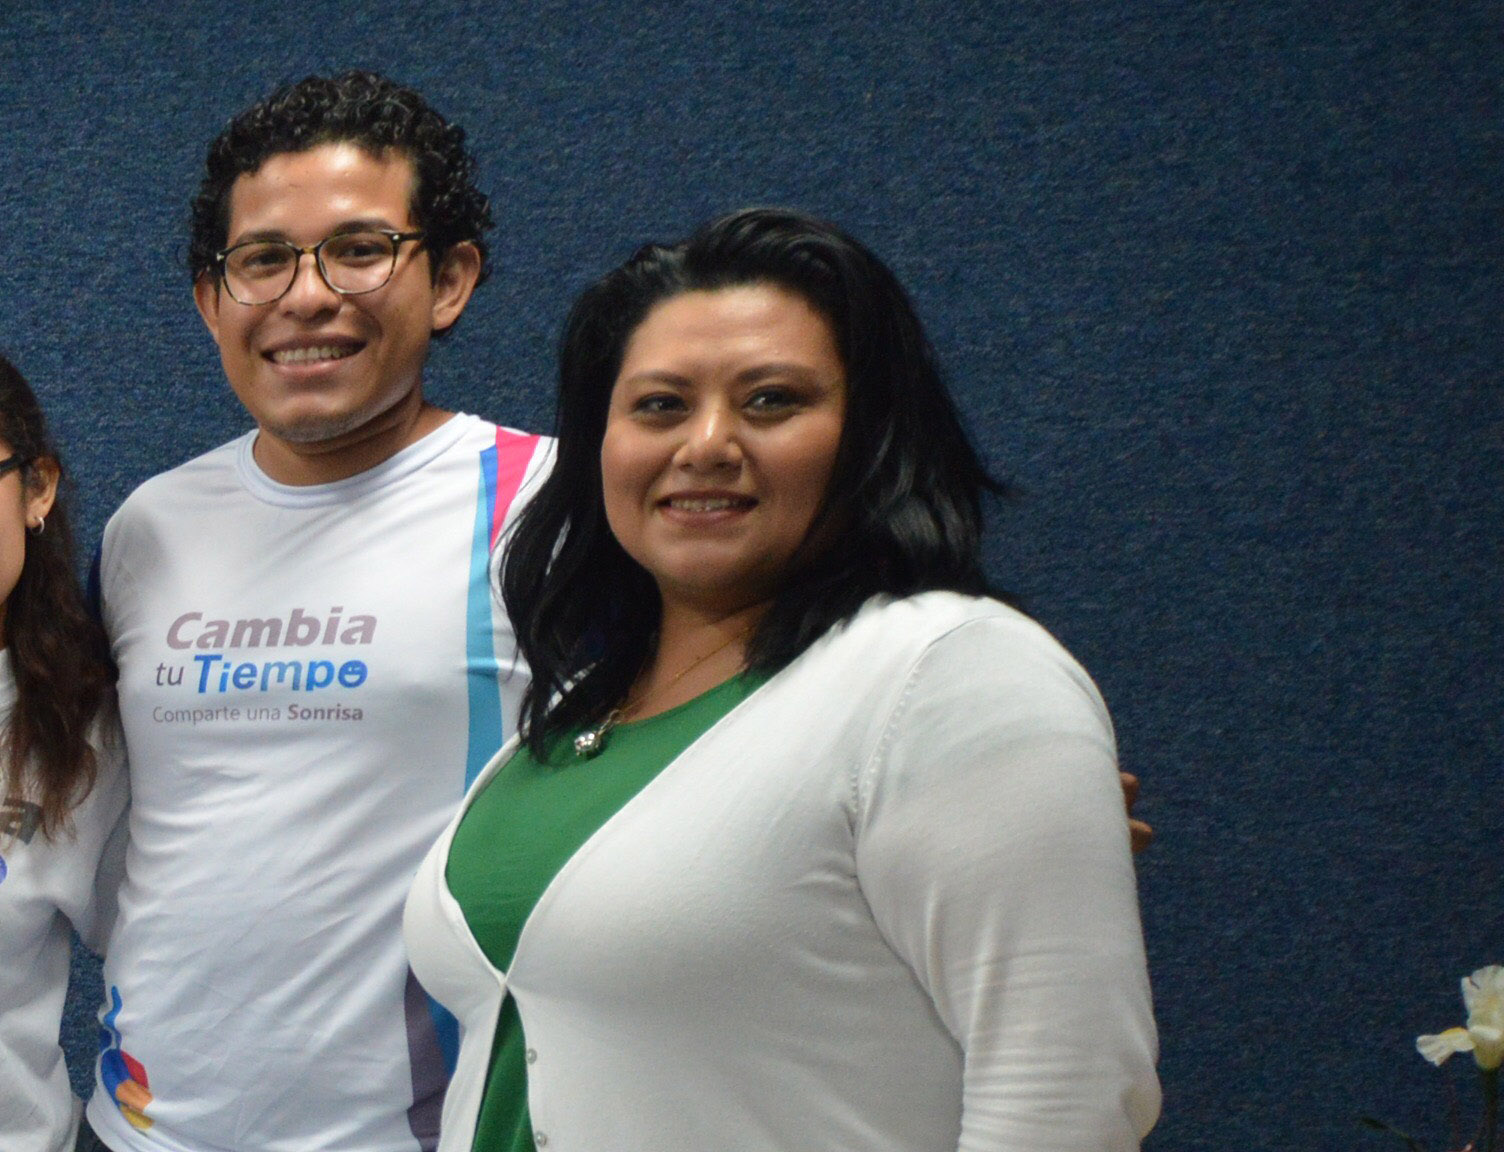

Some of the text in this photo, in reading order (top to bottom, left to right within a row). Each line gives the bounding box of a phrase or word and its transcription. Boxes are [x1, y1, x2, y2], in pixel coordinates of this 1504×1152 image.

[166, 606, 378, 650] Cambia
[155, 654, 368, 694] tu Tiempo
[153, 703, 364, 725] Comparte una Sonrisa
